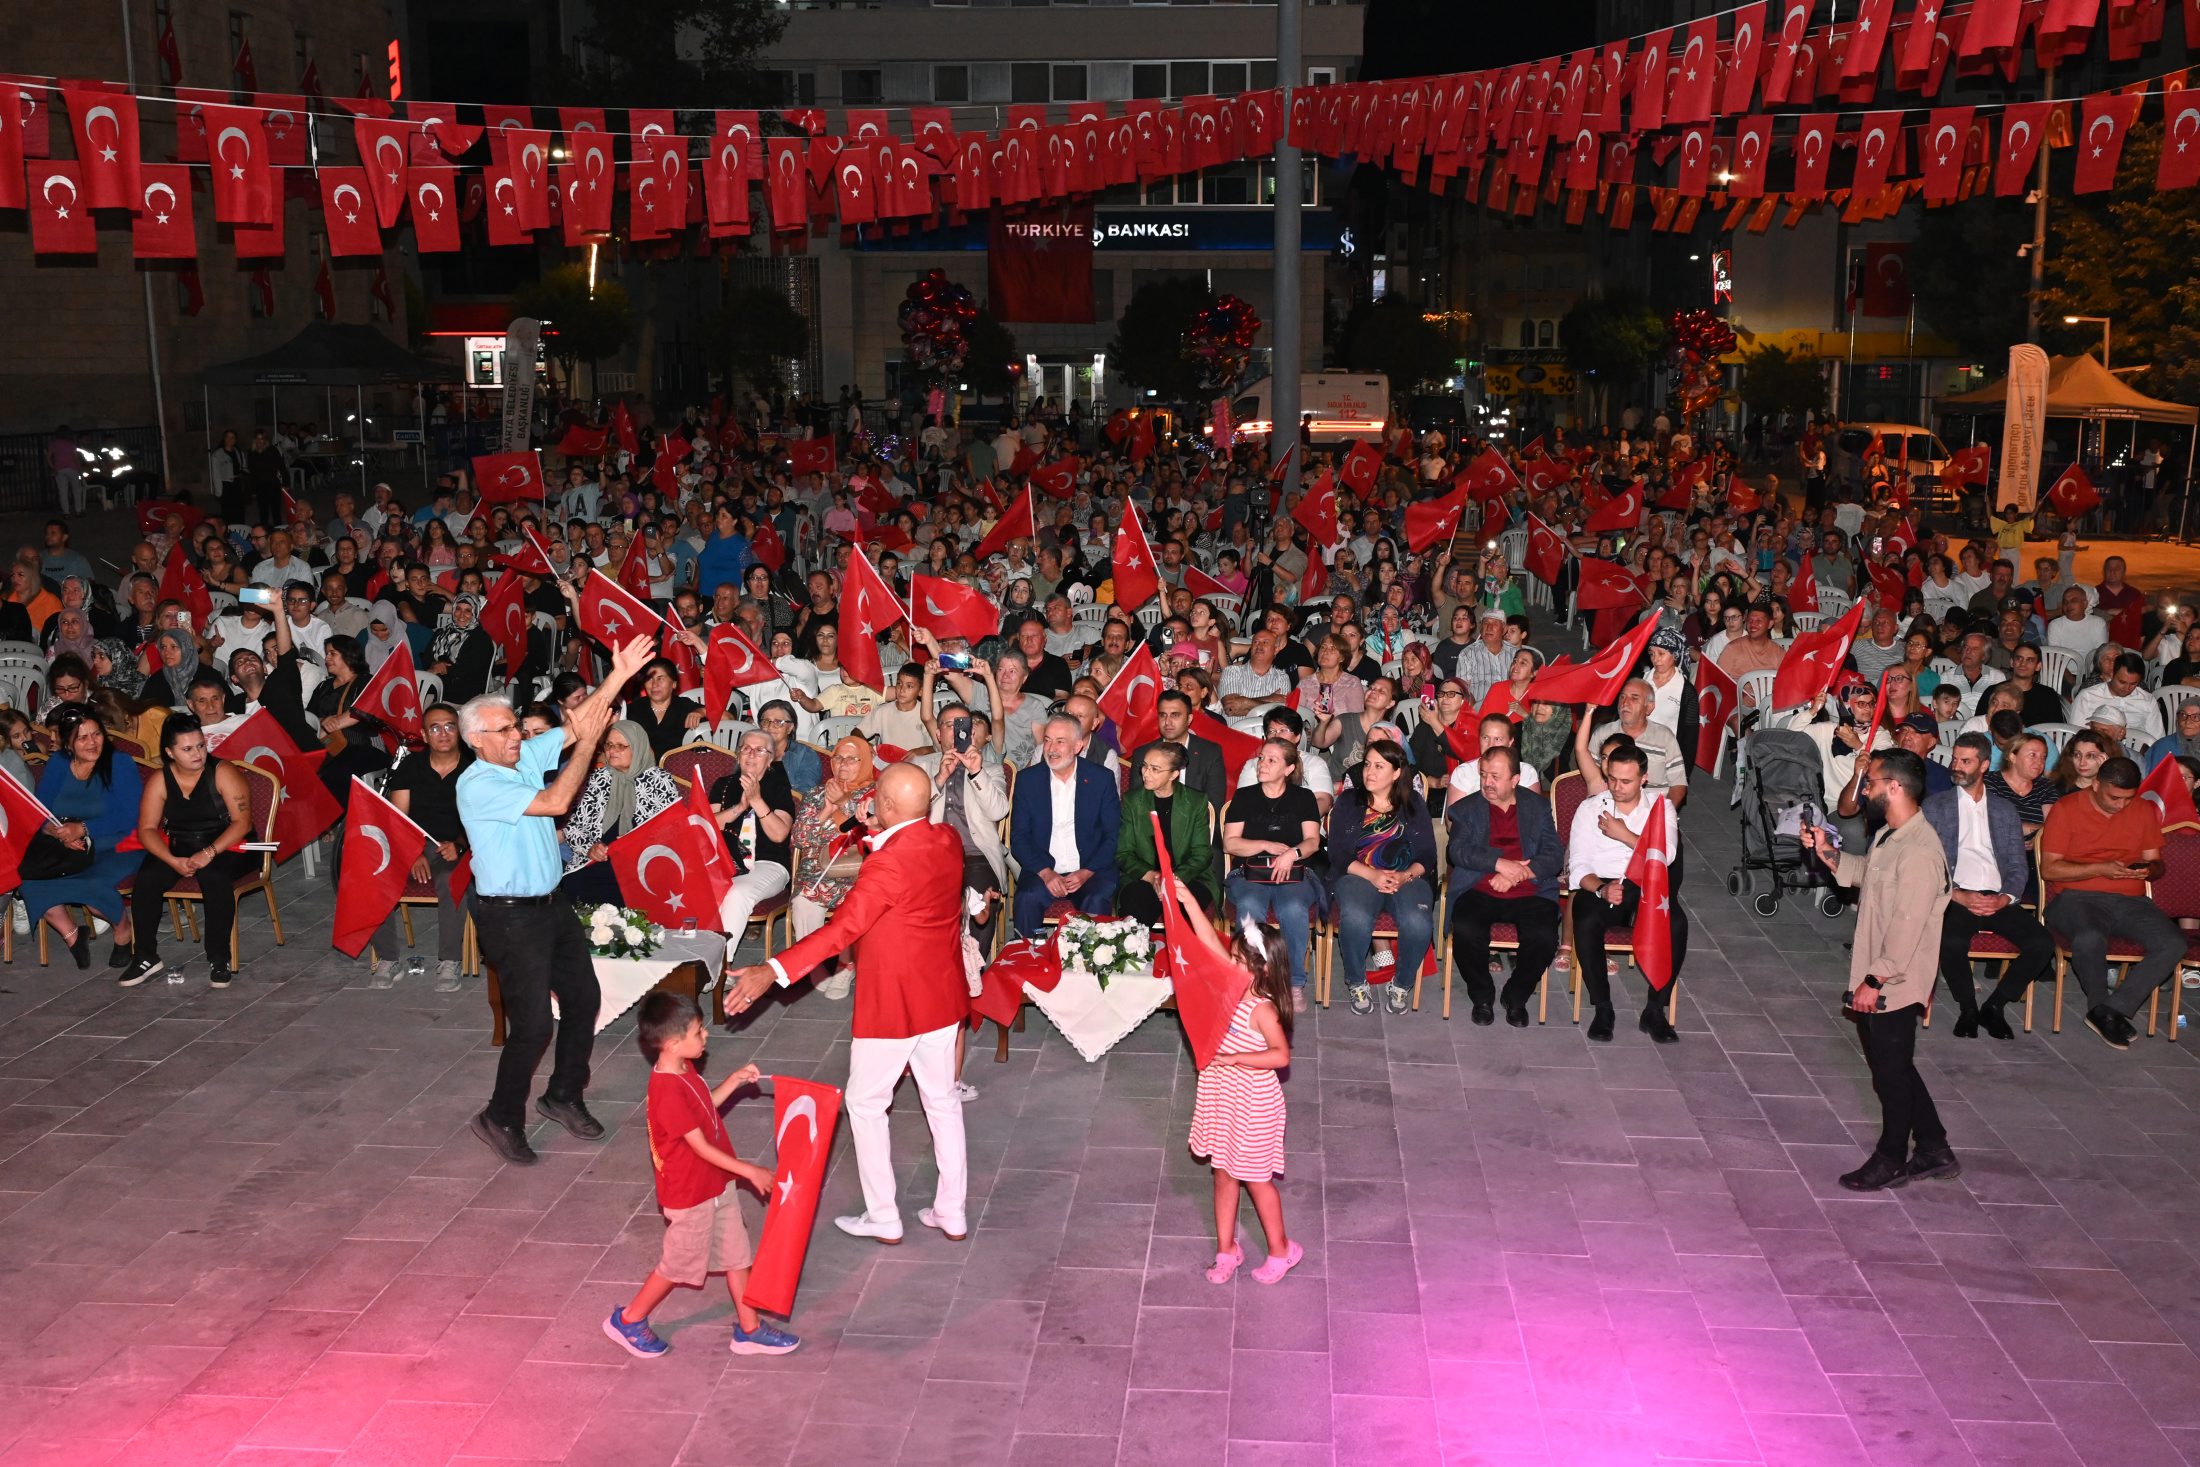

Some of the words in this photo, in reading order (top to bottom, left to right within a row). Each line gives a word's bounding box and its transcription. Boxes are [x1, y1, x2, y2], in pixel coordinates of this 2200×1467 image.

[1005, 223, 1084, 237] TÜRKİYE
[1107, 223, 1190, 237] BANKASI
[505, 362, 519, 416] BELEDİYESİ
[517, 383, 531, 439] BAŞKANLIĞI
[1338, 409, 1358, 419] 112
[503, 417, 514, 454] SPARTA
